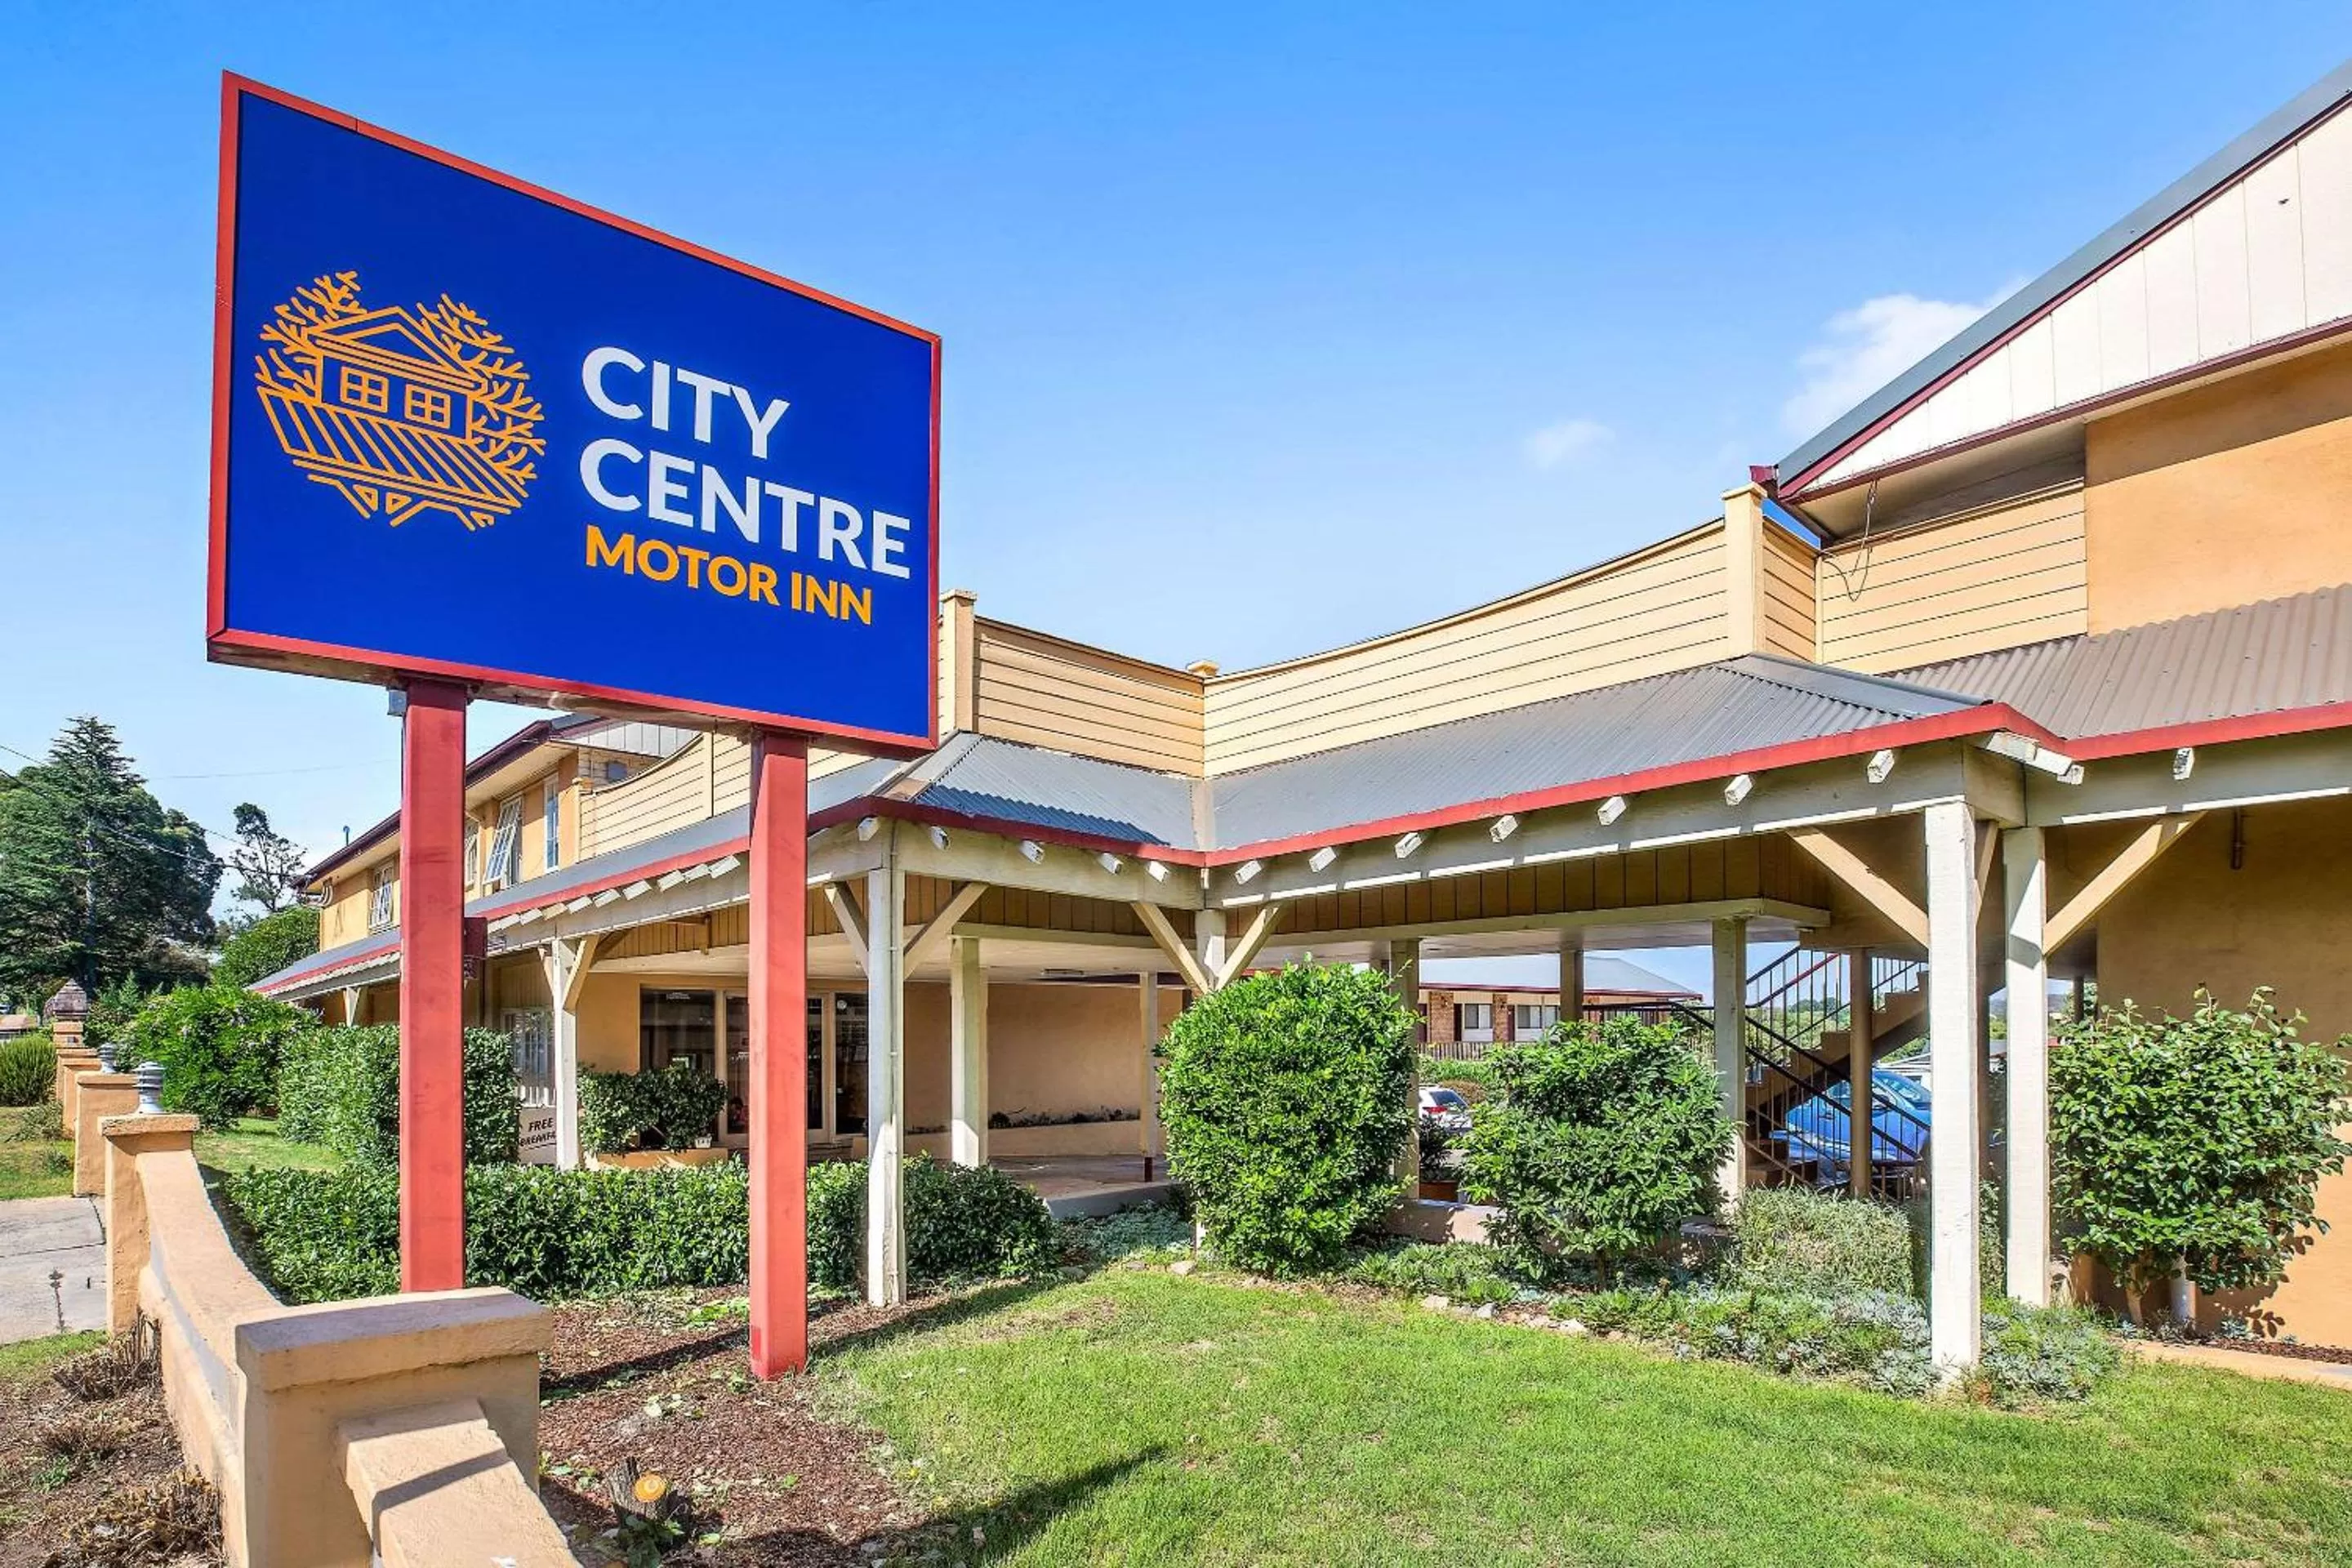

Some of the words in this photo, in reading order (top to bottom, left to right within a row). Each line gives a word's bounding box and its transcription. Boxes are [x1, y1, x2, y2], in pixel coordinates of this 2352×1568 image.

[581, 346, 791, 460] CITY
[580, 438, 911, 579] CENTRE
[586, 524, 780, 606] MOTOR
[791, 572, 872, 625] INN
[528, 1117, 554, 1132] FREE
